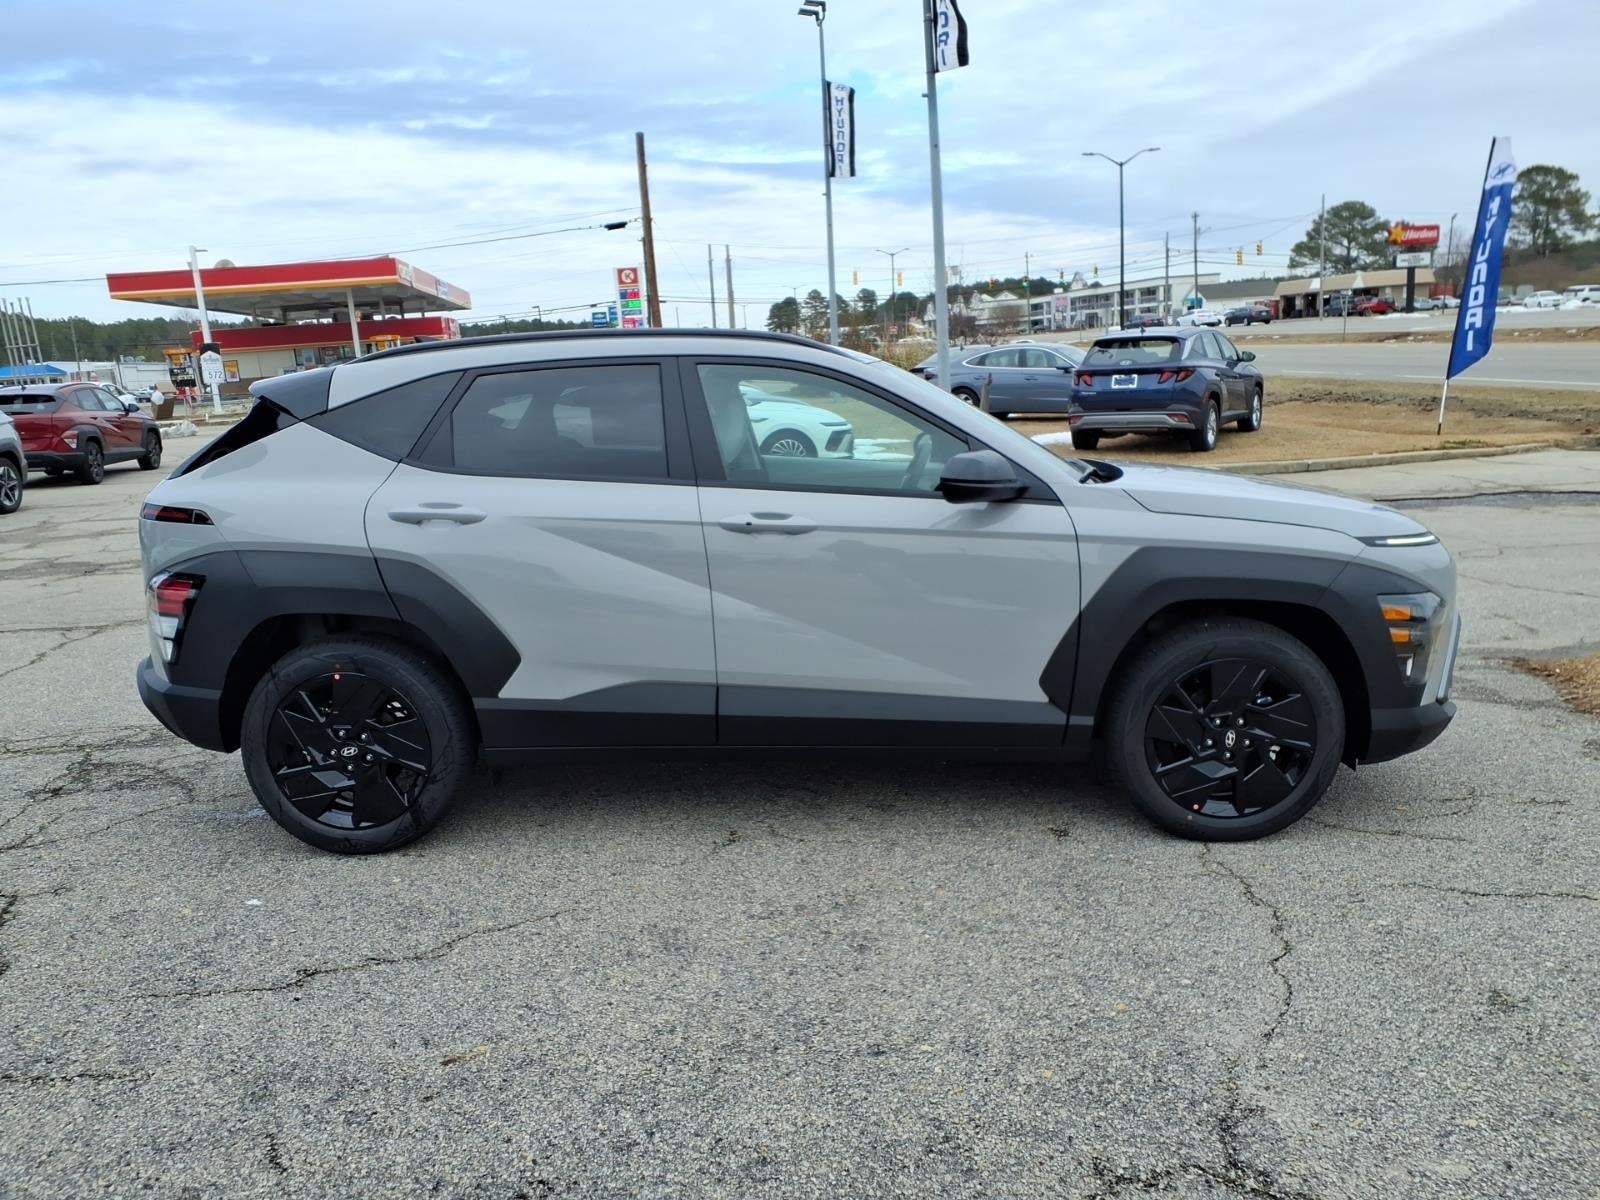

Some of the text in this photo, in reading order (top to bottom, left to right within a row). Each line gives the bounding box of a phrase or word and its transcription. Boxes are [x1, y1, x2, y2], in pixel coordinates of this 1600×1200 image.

[835, 96, 845, 176] HYUNDAI
[1464, 196, 1501, 351] HYUNDAI
[208, 370, 223, 379] 572
